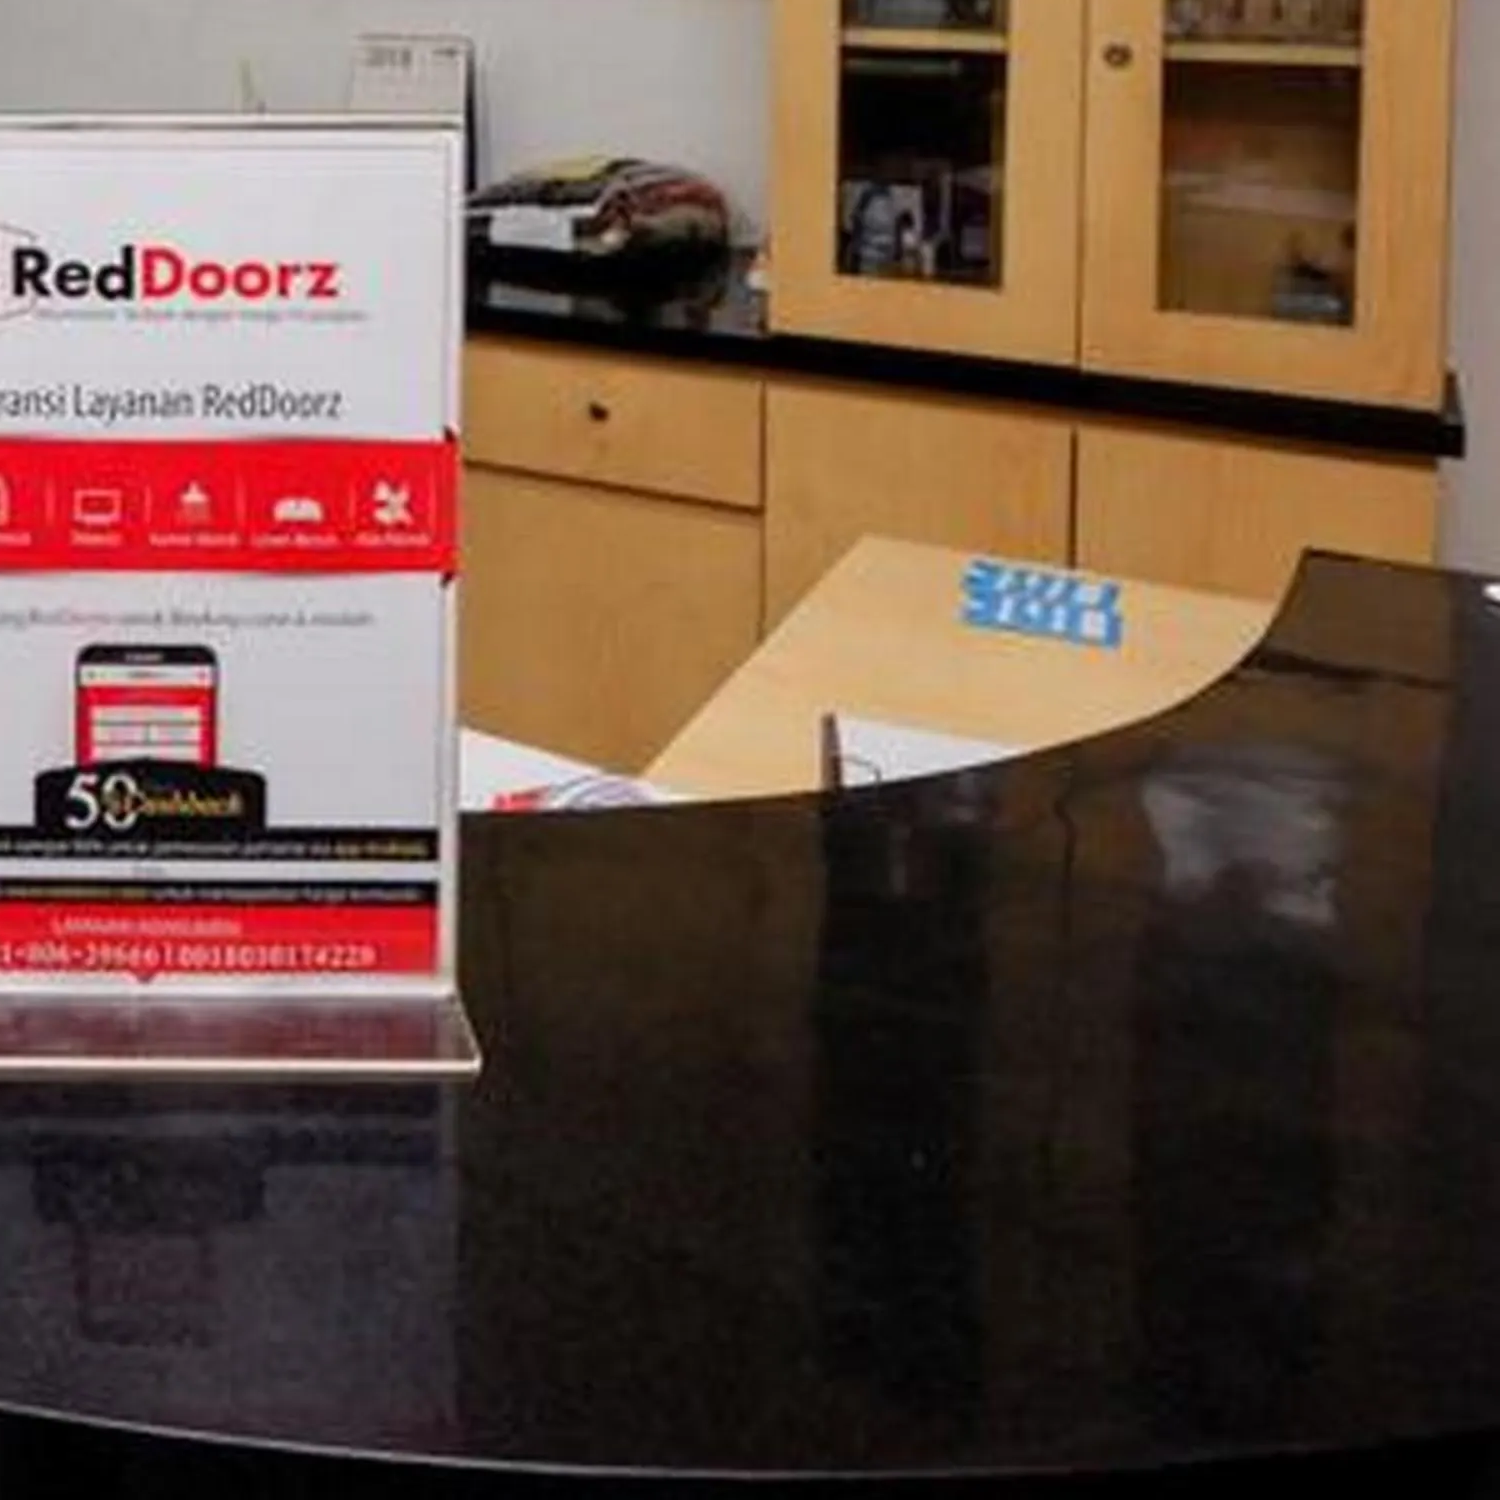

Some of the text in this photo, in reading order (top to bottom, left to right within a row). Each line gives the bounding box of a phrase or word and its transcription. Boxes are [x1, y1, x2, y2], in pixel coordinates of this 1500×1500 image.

[12, 246, 339, 301] RedDoorz
[73, 385, 196, 426] Layanan
[202, 385, 344, 420] RedDoorz
